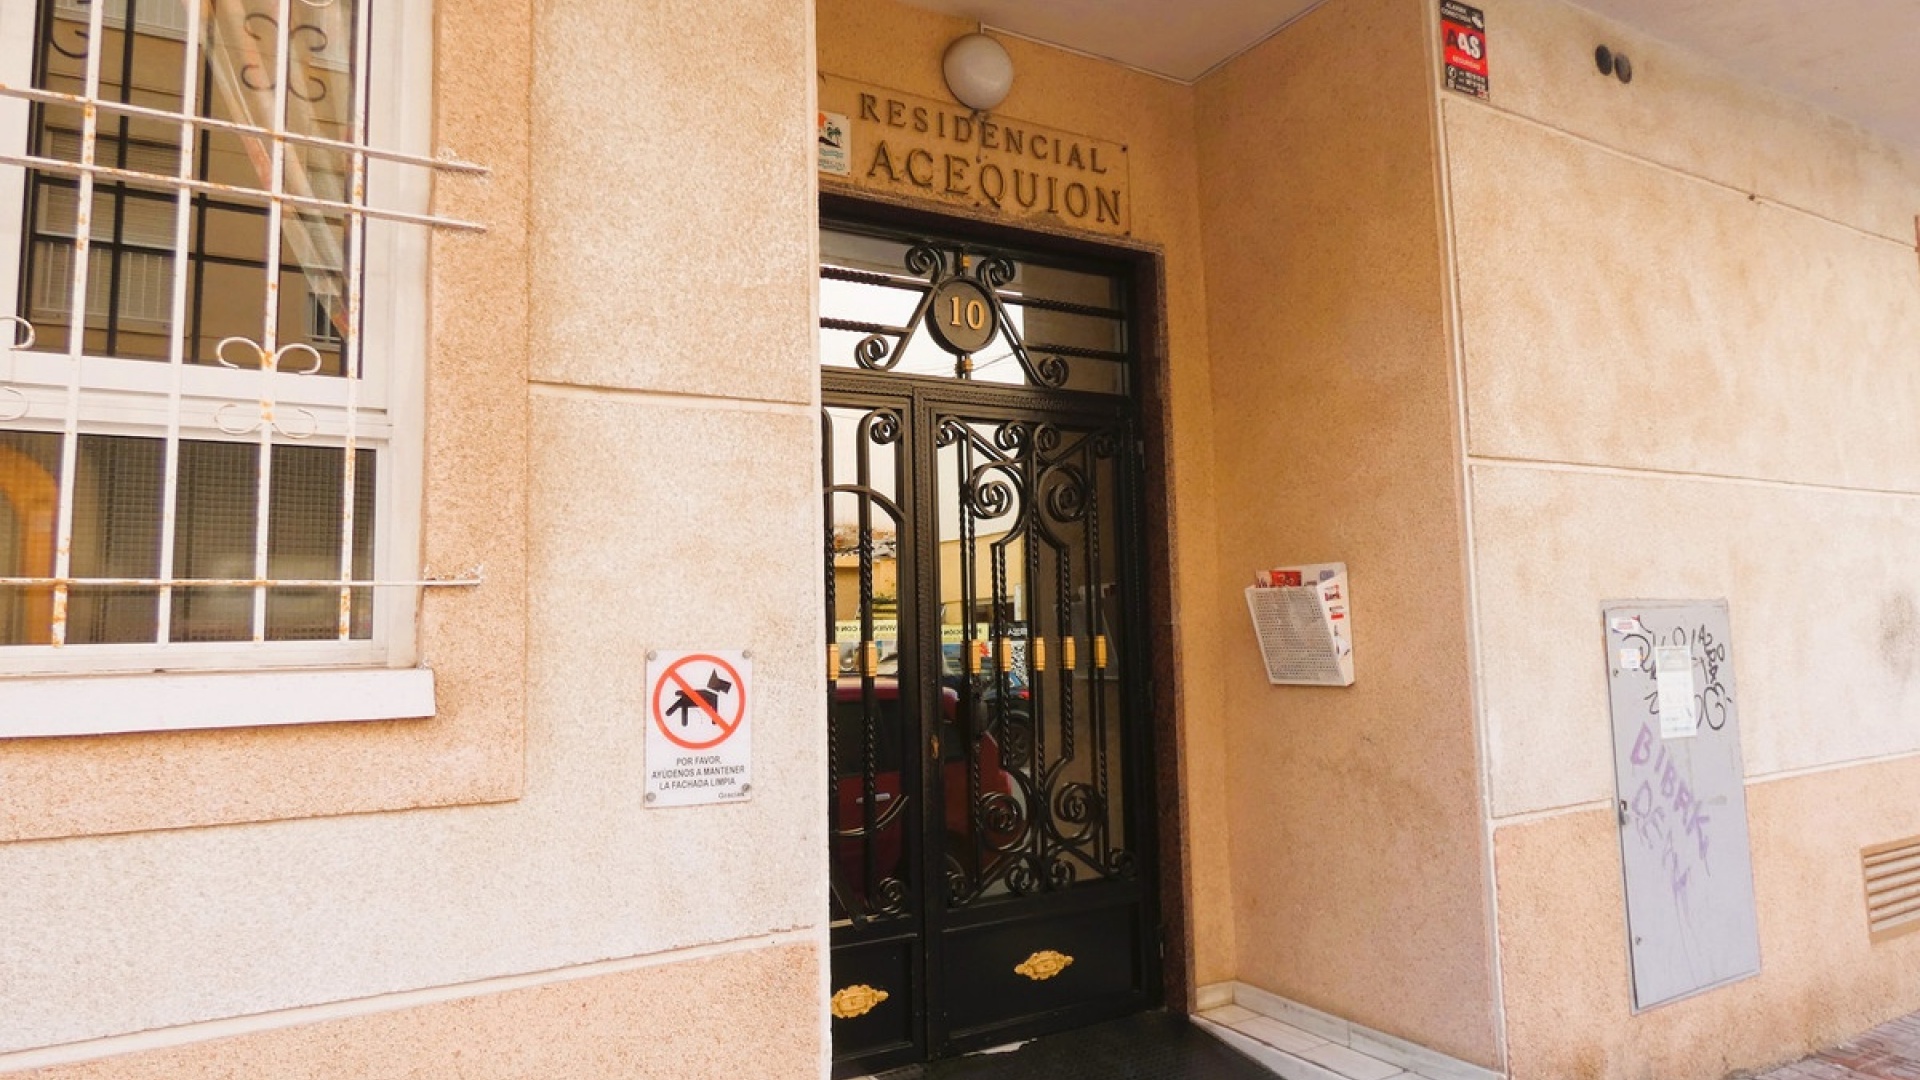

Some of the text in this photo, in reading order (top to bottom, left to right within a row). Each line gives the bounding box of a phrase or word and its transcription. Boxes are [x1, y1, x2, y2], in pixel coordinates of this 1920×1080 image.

[860, 92, 1106, 174] RESIDENCIAL
[867, 139, 1121, 225] ACEQUION
[951, 296, 985, 330] 10
[676, 757, 693, 766] POR
[696, 768, 702, 776] A
[703, 765, 744, 776] MANTENER
[659, 777, 736, 790] LA FACHADA LIMPIA
